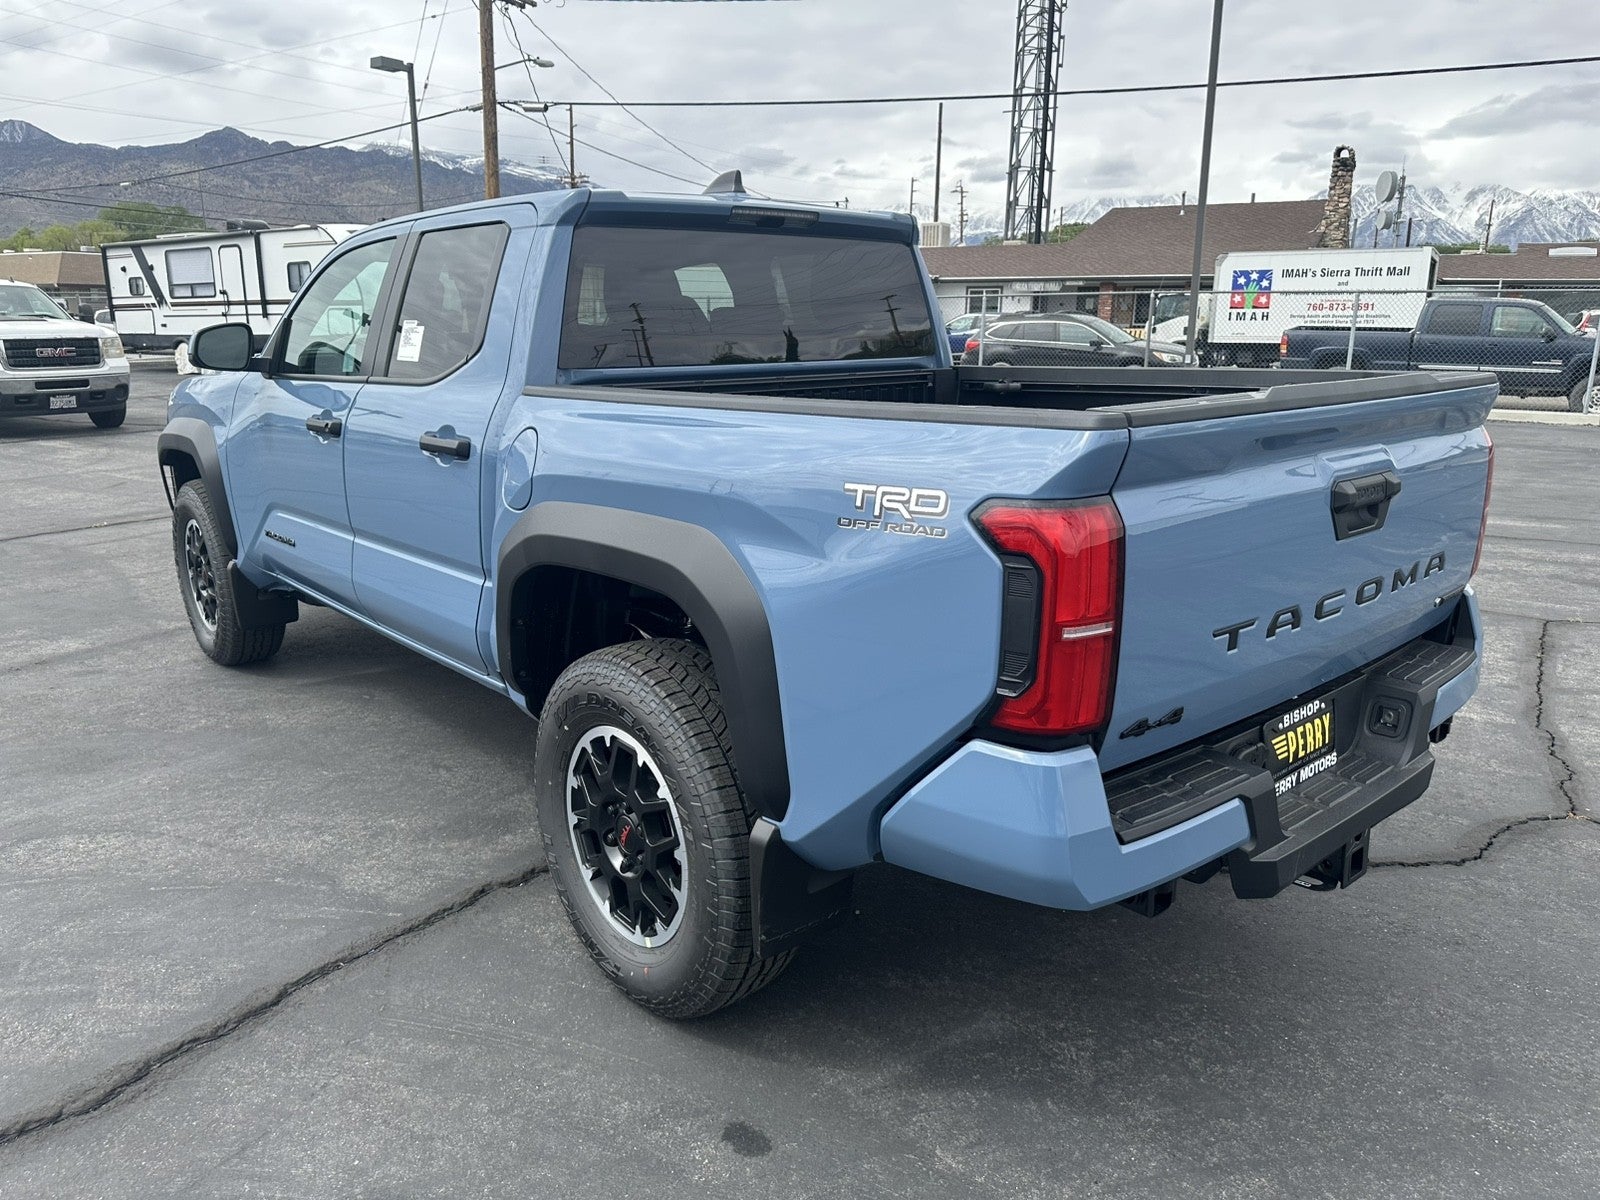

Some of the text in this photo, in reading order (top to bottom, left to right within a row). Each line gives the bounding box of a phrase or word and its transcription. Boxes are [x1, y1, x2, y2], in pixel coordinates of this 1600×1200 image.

[1281, 266, 1410, 278] IMAH's Sierra Thrift Mall
[1228, 311, 1269, 321] IMAH
[36, 347, 77, 358] GMC
[843, 482, 950, 522] TRD
[264, 529, 296, 547] TACOMA
[837, 517, 948, 539] OFF ROAD
[1212, 551, 1445, 655] TACOMA
[1283, 700, 1320, 729] BISHOP
[1287, 712, 1330, 763] PERRY
[1274, 751, 1338, 797] ERRY MOTORS
